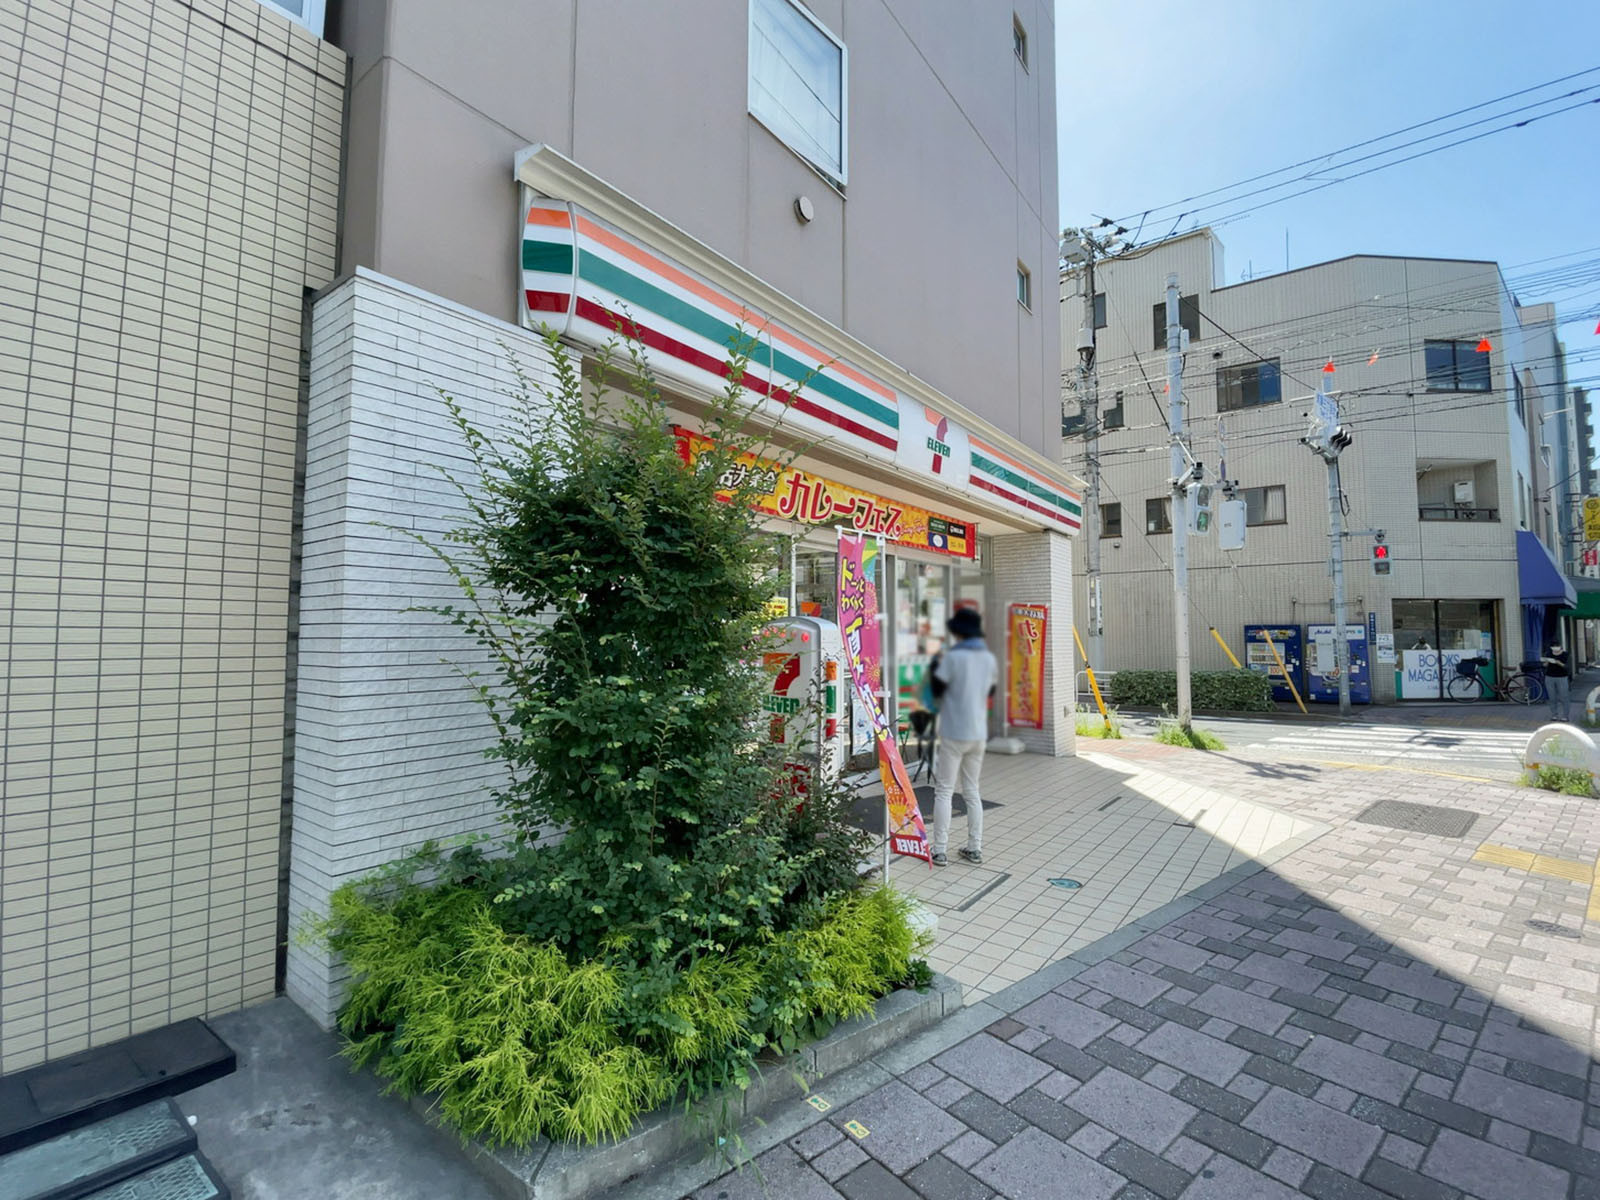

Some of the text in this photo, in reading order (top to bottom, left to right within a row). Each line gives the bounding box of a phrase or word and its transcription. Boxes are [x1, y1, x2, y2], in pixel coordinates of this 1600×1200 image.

[927, 437, 951, 458] ELEVEN
[780, 473, 902, 538] カレーフェス
[1418, 654, 1460, 667] BOOKS
[763, 695, 800, 714] LEVEN
